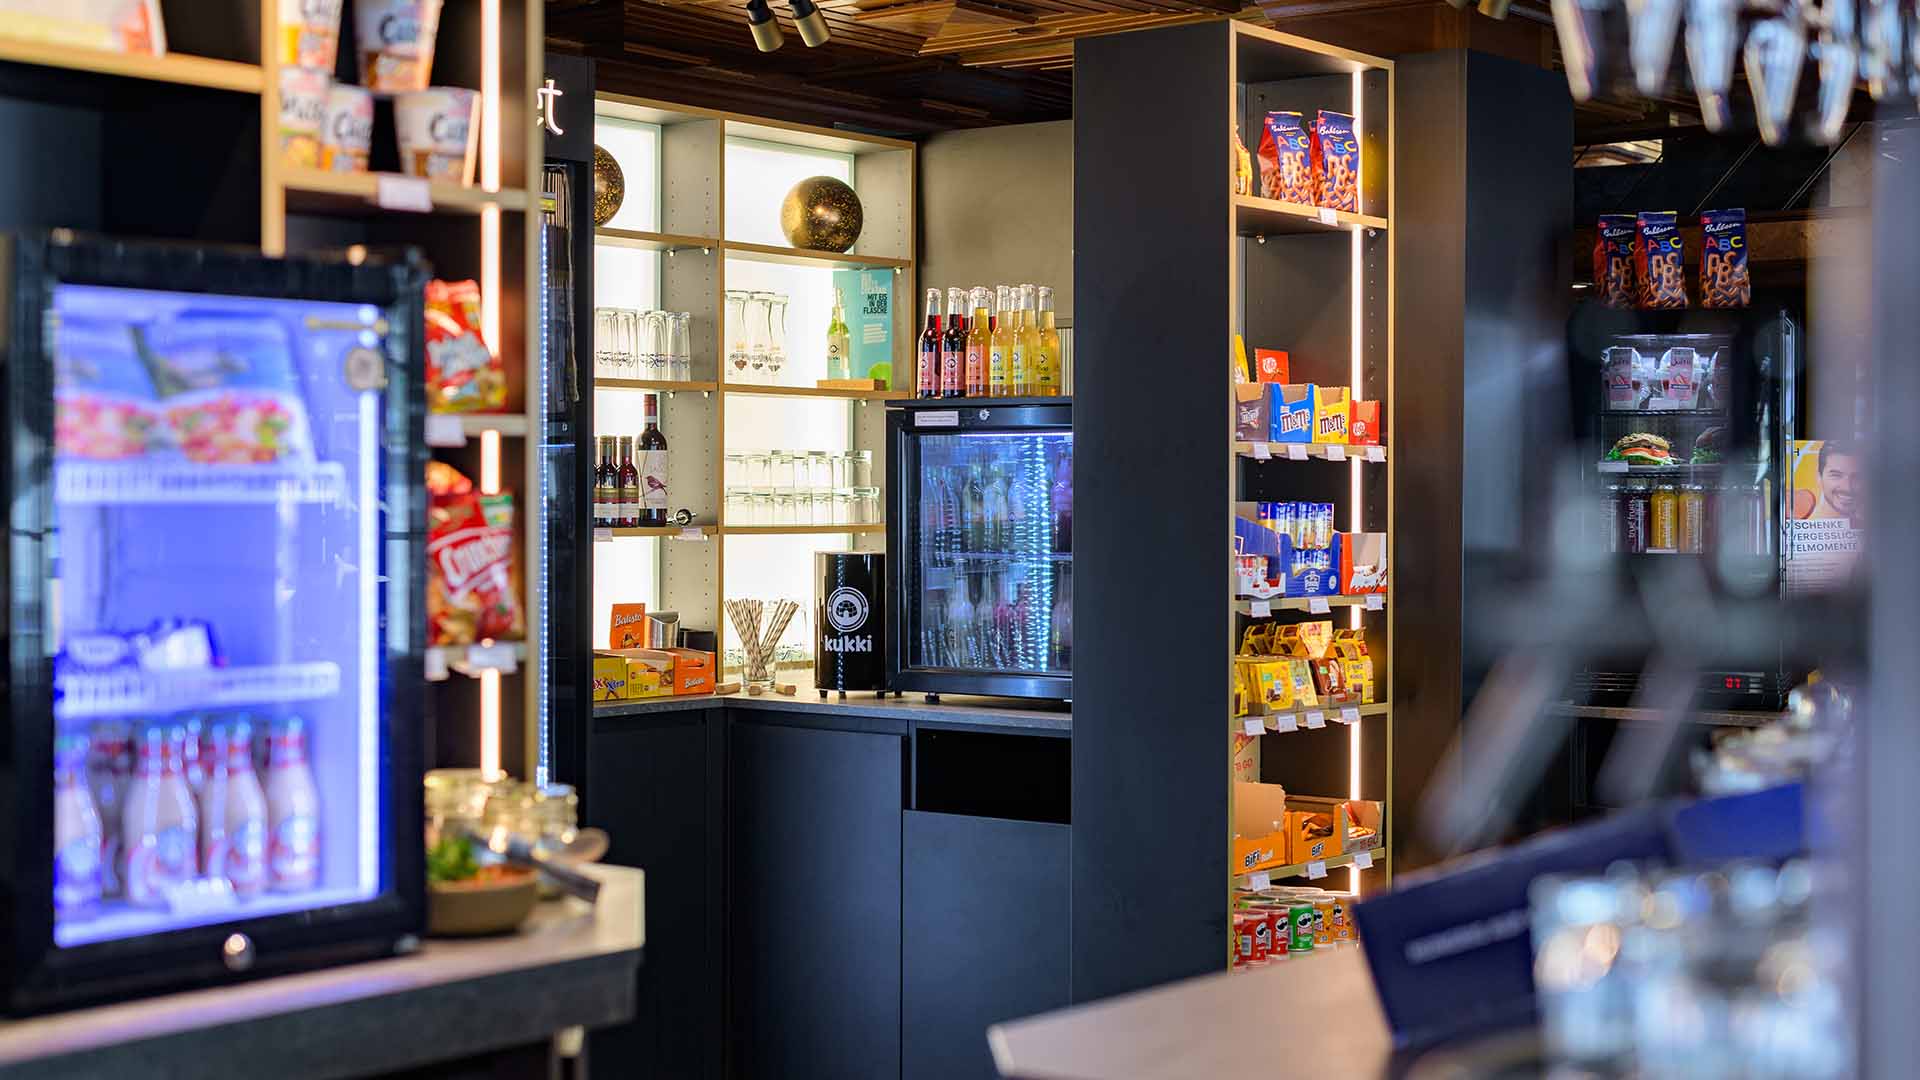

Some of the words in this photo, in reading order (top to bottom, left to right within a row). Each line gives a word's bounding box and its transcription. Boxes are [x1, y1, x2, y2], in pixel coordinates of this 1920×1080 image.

[1647, 237, 1681, 252] ABC
[1705, 236, 1743, 251] ABC
[824, 634, 873, 652] kukki
